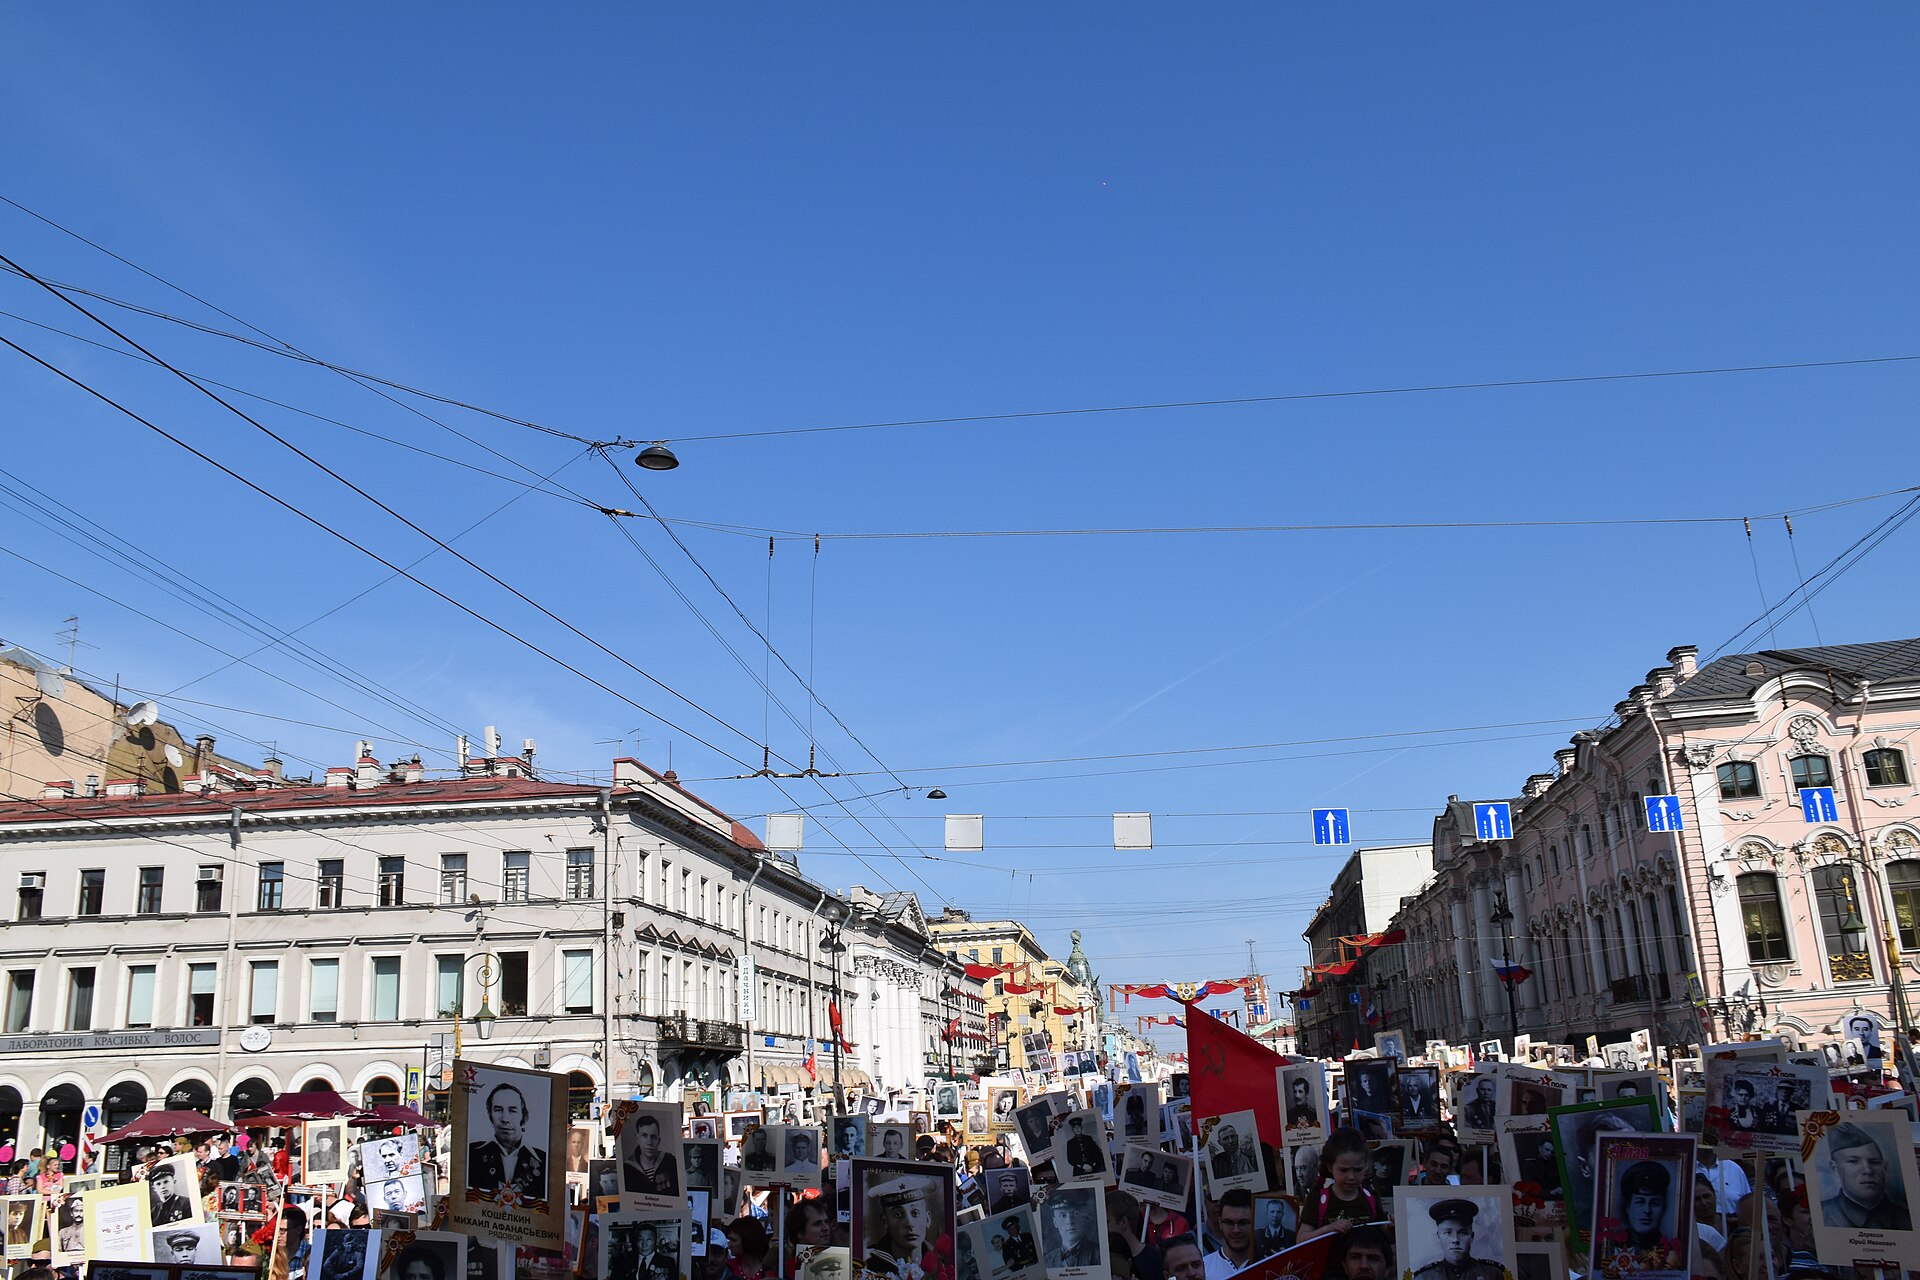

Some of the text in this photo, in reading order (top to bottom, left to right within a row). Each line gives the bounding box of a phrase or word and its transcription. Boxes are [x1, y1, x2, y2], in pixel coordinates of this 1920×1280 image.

[8, 1033, 201, 1050] ЛАБОРАТОРИЯ КРАСИВЫХ ВОЛОС
[453, 1215, 560, 1241] МИХАИЛ АФАНАСЬЕВИЧ
[488, 1229, 523, 1242] РЯДОВОЙ
